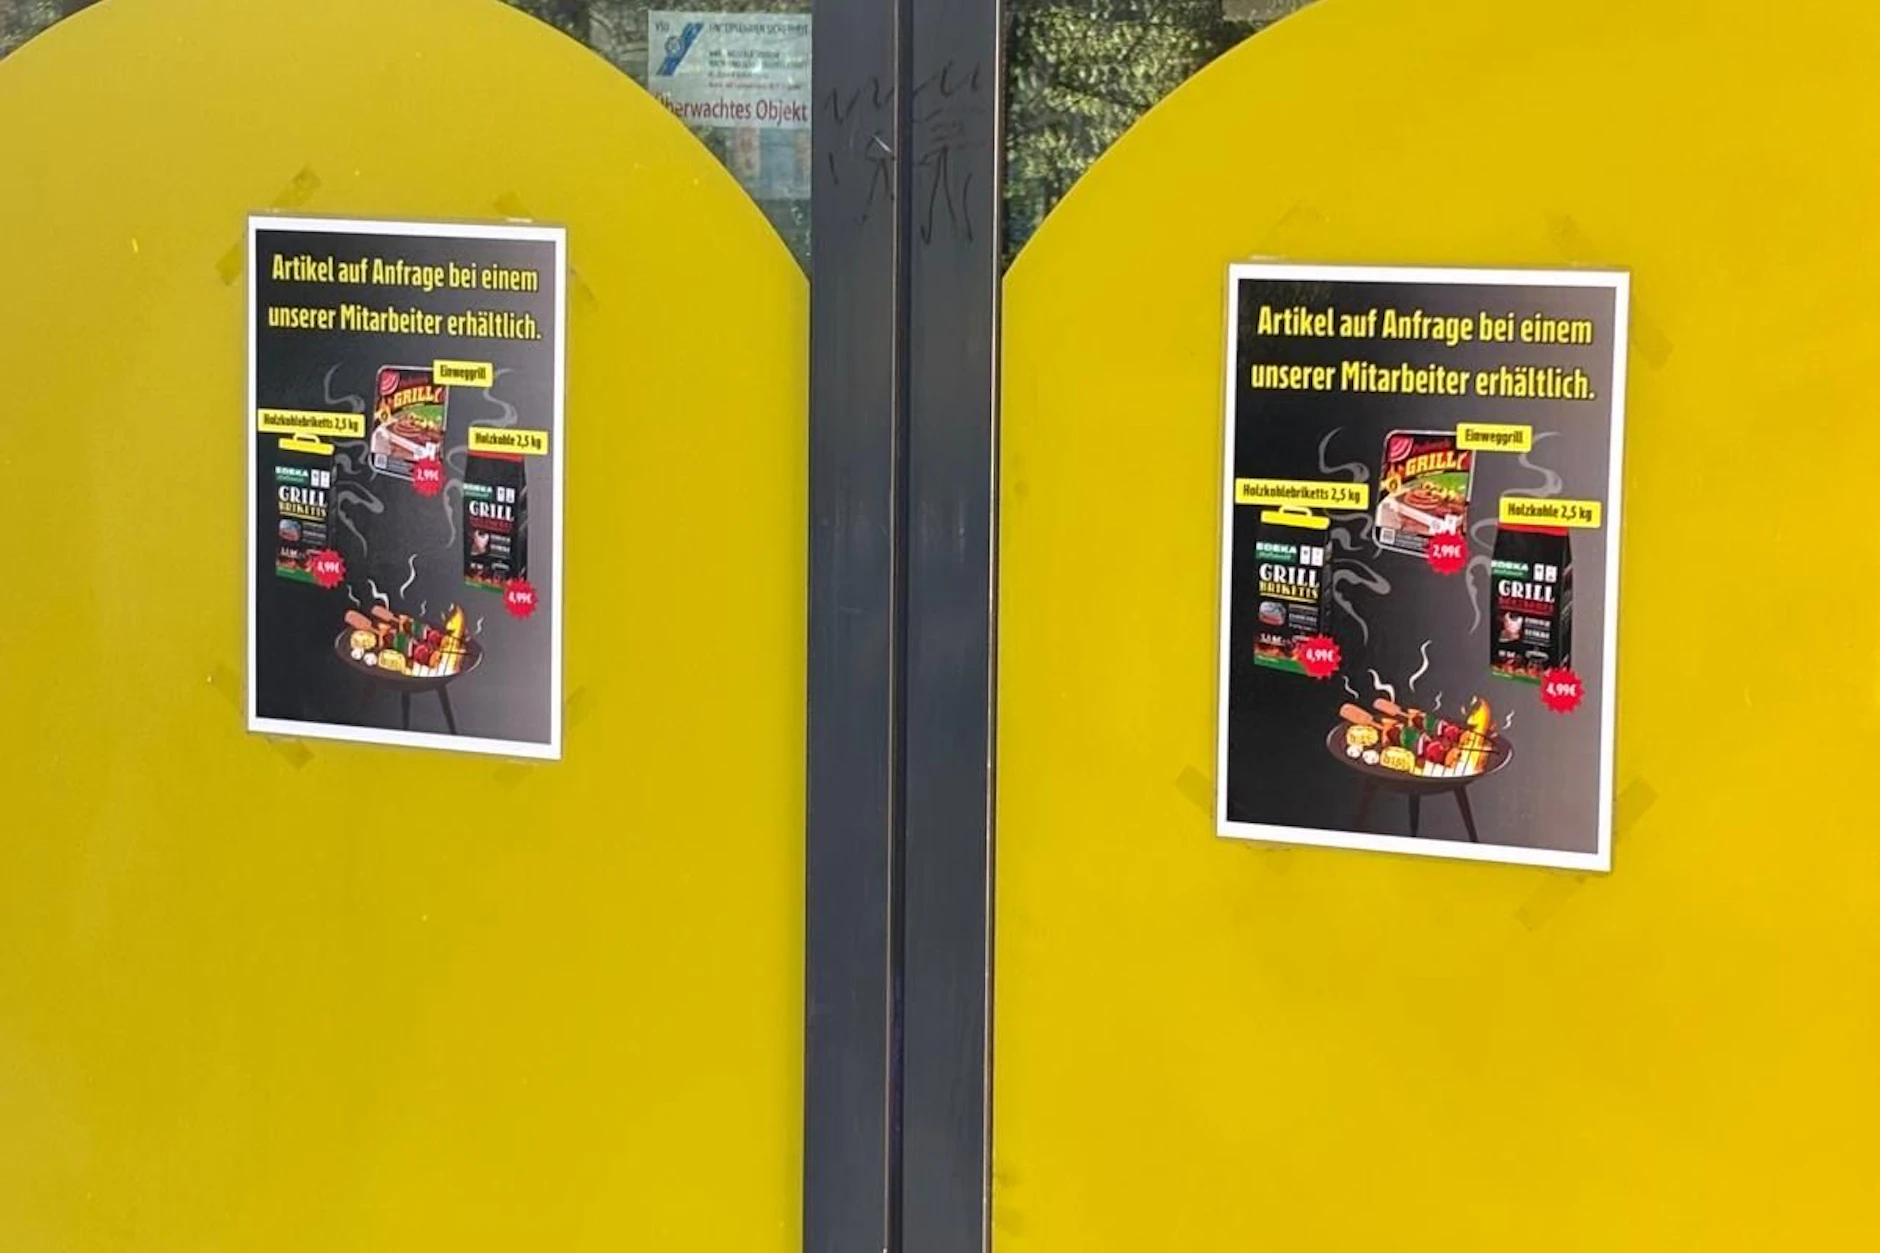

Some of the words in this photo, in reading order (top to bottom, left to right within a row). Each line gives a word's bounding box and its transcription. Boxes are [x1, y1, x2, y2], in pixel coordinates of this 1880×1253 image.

[756, 99, 808, 126] Objekt
[272, 254, 334, 283] Artikel
[338, 258, 368, 284] auf
[372, 258, 444, 292] Anfrage
[449, 262, 476, 288] bei
[482, 265, 538, 291] einem
[269, 305, 336, 329] unserer
[340, 304, 442, 335] Mitarbeiter
[447, 309, 541, 340] erhältlich.
[1257, 305, 1334, 337] Artikel
[1340, 308, 1377, 338] auf
[1382, 308, 1473, 347] Anfrage
[1479, 311, 1515, 342] bei
[1520, 313, 1592, 344] einem
[440, 365, 486, 381] Einweggrill
[1251, 361, 1335, 391] unserer
[1341, 360, 1469, 396] Mitarbeiter
[1475, 362, 1596, 400] erhältlich.
[263, 413, 333, 429] Holzkohlebriketts
[334, 417, 347, 432] 2,5
[349, 418, 359, 432] kg
[475, 432, 515, 446] Holzkohle
[517, 436, 529, 449] 2,5
[531, 437, 542, 450] kg
[1465, 428, 1524, 446] Einweggrill
[278, 485, 327, 507] GRILL
[1243, 483, 1329, 500] Holzkohlebriketts
[1331, 487, 1347, 503] 2,5
[1349, 488, 1361, 504] kg
[469, 501, 514, 522] GRILL
[1508, 503, 1558, 519] Holzkohle
[1560, 505, 1576, 520] 2,5
[1579, 506, 1592, 522] kg
[1432, 544, 1462, 558] 2,99€
[1259, 563, 1320, 588] GRILL
[1499, 580, 1555, 603] GRILL
[1546, 683, 1577, 697] 4,99€
